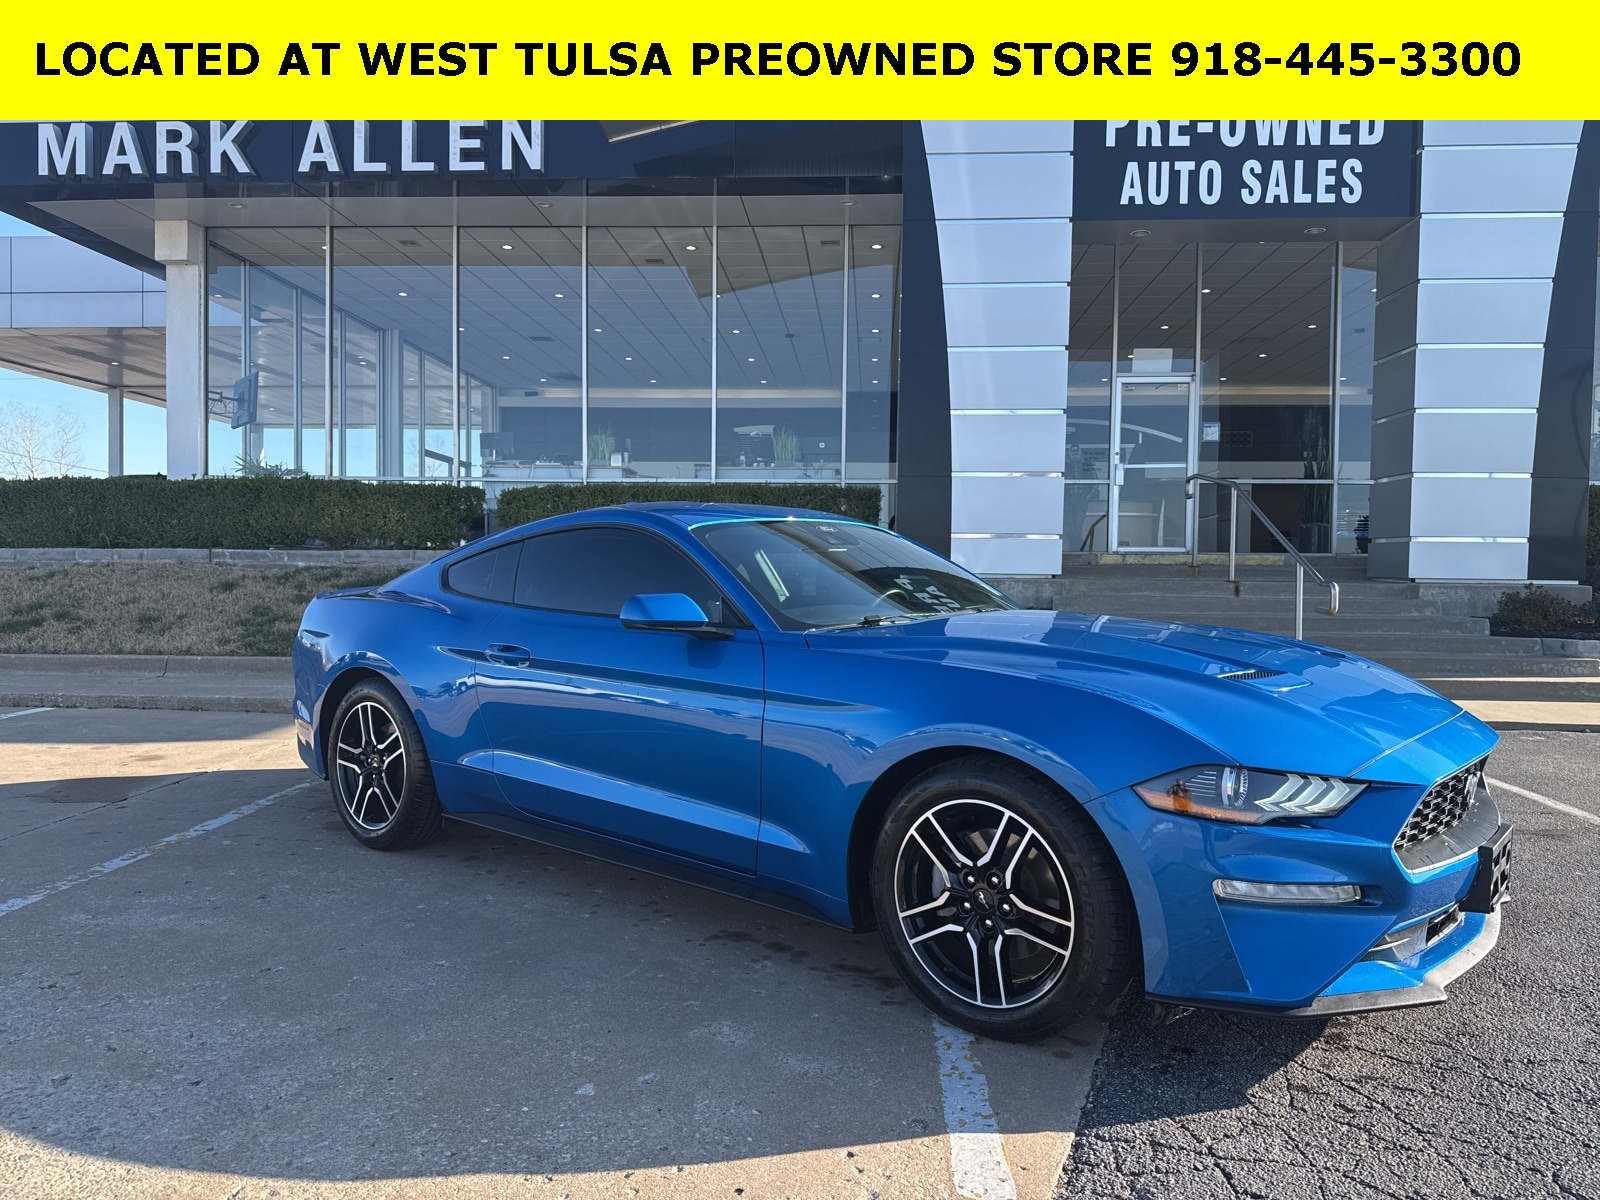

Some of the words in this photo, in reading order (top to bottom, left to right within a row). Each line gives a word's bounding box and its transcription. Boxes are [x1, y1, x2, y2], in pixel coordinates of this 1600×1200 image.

[37, 120, 254, 176] MARK
[297, 120, 545, 173] ALLEN
[1105, 120, 1385, 147] PRE-OWNED
[1119, 160, 1222, 205] AUTO
[1240, 158, 1363, 204] SALES
